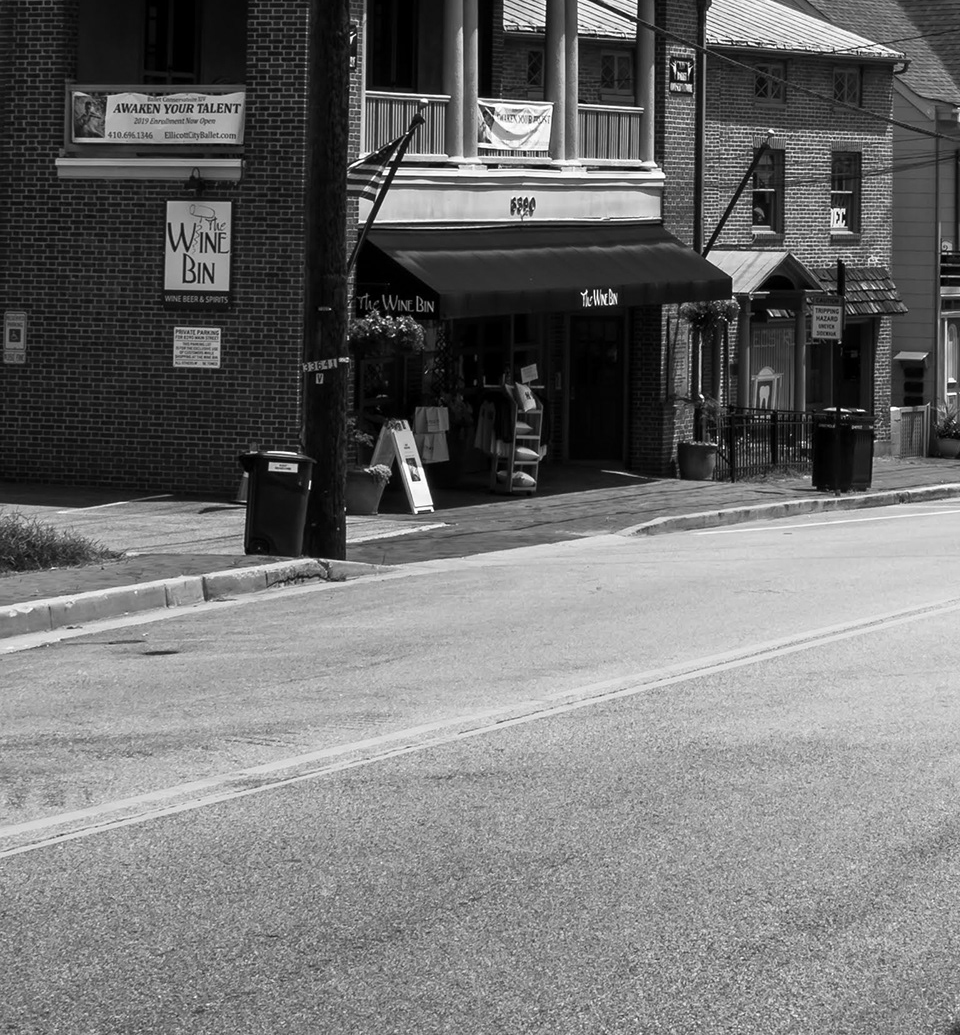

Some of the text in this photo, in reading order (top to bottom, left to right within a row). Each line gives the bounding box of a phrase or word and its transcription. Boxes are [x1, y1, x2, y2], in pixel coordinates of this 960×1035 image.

[113, 103, 242, 114] AWAKEN YOUR TALENT
[200, 118, 217, 126] Open
[165, 131, 237, 141] EllicottCityBallet.com
[205, 216, 227, 232] The
[167, 222, 230, 254] WINE
[182, 253, 215, 284] BIN
[164, 295, 182, 303] WINE
[182, 295, 199, 303] BEER
[205, 296, 229, 304] SPIRITS
[356, 293, 380, 311] The
[416, 295, 435, 313] BIN
[580, 289, 593, 307] The
